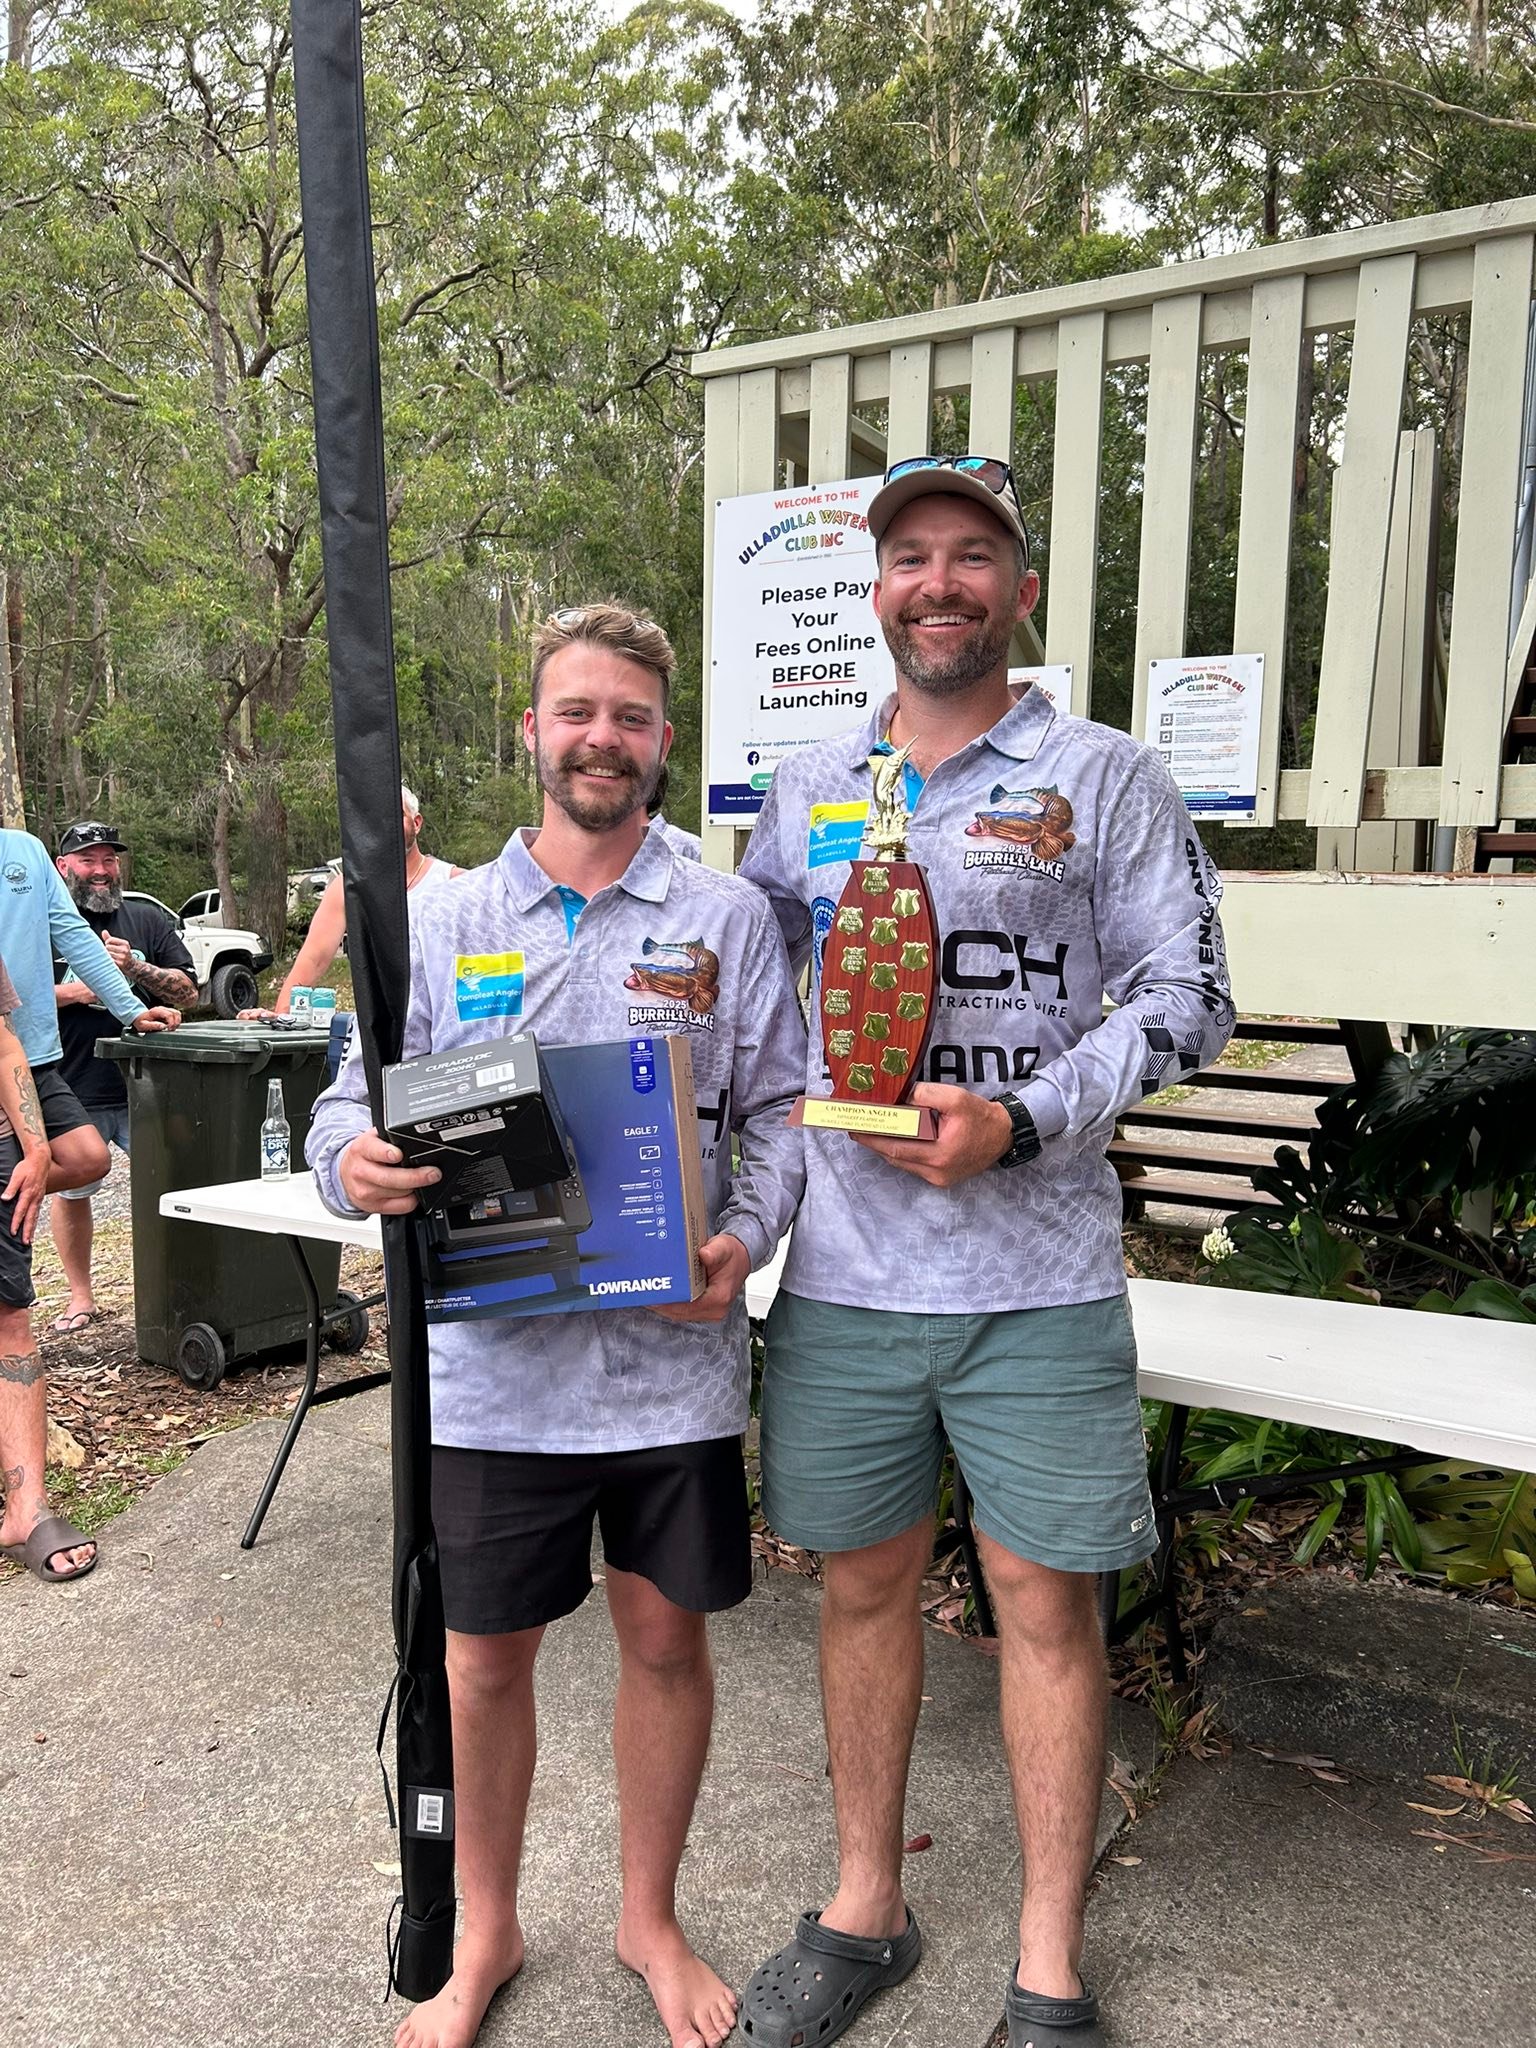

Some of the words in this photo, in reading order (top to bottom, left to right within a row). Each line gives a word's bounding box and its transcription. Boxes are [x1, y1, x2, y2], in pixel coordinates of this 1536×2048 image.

[774, 494, 822, 509] WELCOME
[824, 492, 838, 502] TO
[842, 490, 860, 500] THE
[738, 511, 816, 565] ULLADULLA
[819, 509, 868, 532] WATER
[785, 535, 818, 552] CLUB
[820, 532, 844, 548] INC
[761, 583, 827, 606] Please
[834, 581, 872, 600] Pay
[792, 611, 838, 628] Your
[756, 643, 800, 658] Fees
[807, 634, 876, 654] Online
[772, 662, 856, 683] BEFORE
[1162, 673, 1204, 696] ULLADULLA
[1206, 673, 1232, 685] WATER
[1187, 684, 1205, 692] CLUB
[760, 690, 868, 711] Launching
[774, 740, 796, 748] updates
[1001, 844, 1028, 854] 2025
[964, 851, 1028, 869] BURRILL
[1029, 856, 1066, 881] LAKE
[458, 991, 494, 1002] Compleat
[496, 989, 522, 998] Angler
[664, 1000, 686, 1010] 2025
[938, 996, 1027, 1010] TRACTING
[628, 1006, 688, 1026] BURRILL
[688, 1010, 715, 1033] LAKE
[425, 1056, 474, 1073] CURADO
[474, 1051, 494, 1061] DC
[826, 1104, 866, 1114] CHAMPION
[868, 1110, 898, 1118] ANGLER
[624, 1126, 651, 1136] EAGLE
[652, 1126, 658, 1134] 7
[268, 1142, 288, 1150] DRY
[589, 1277, 672, 1296] LOWRANCE
